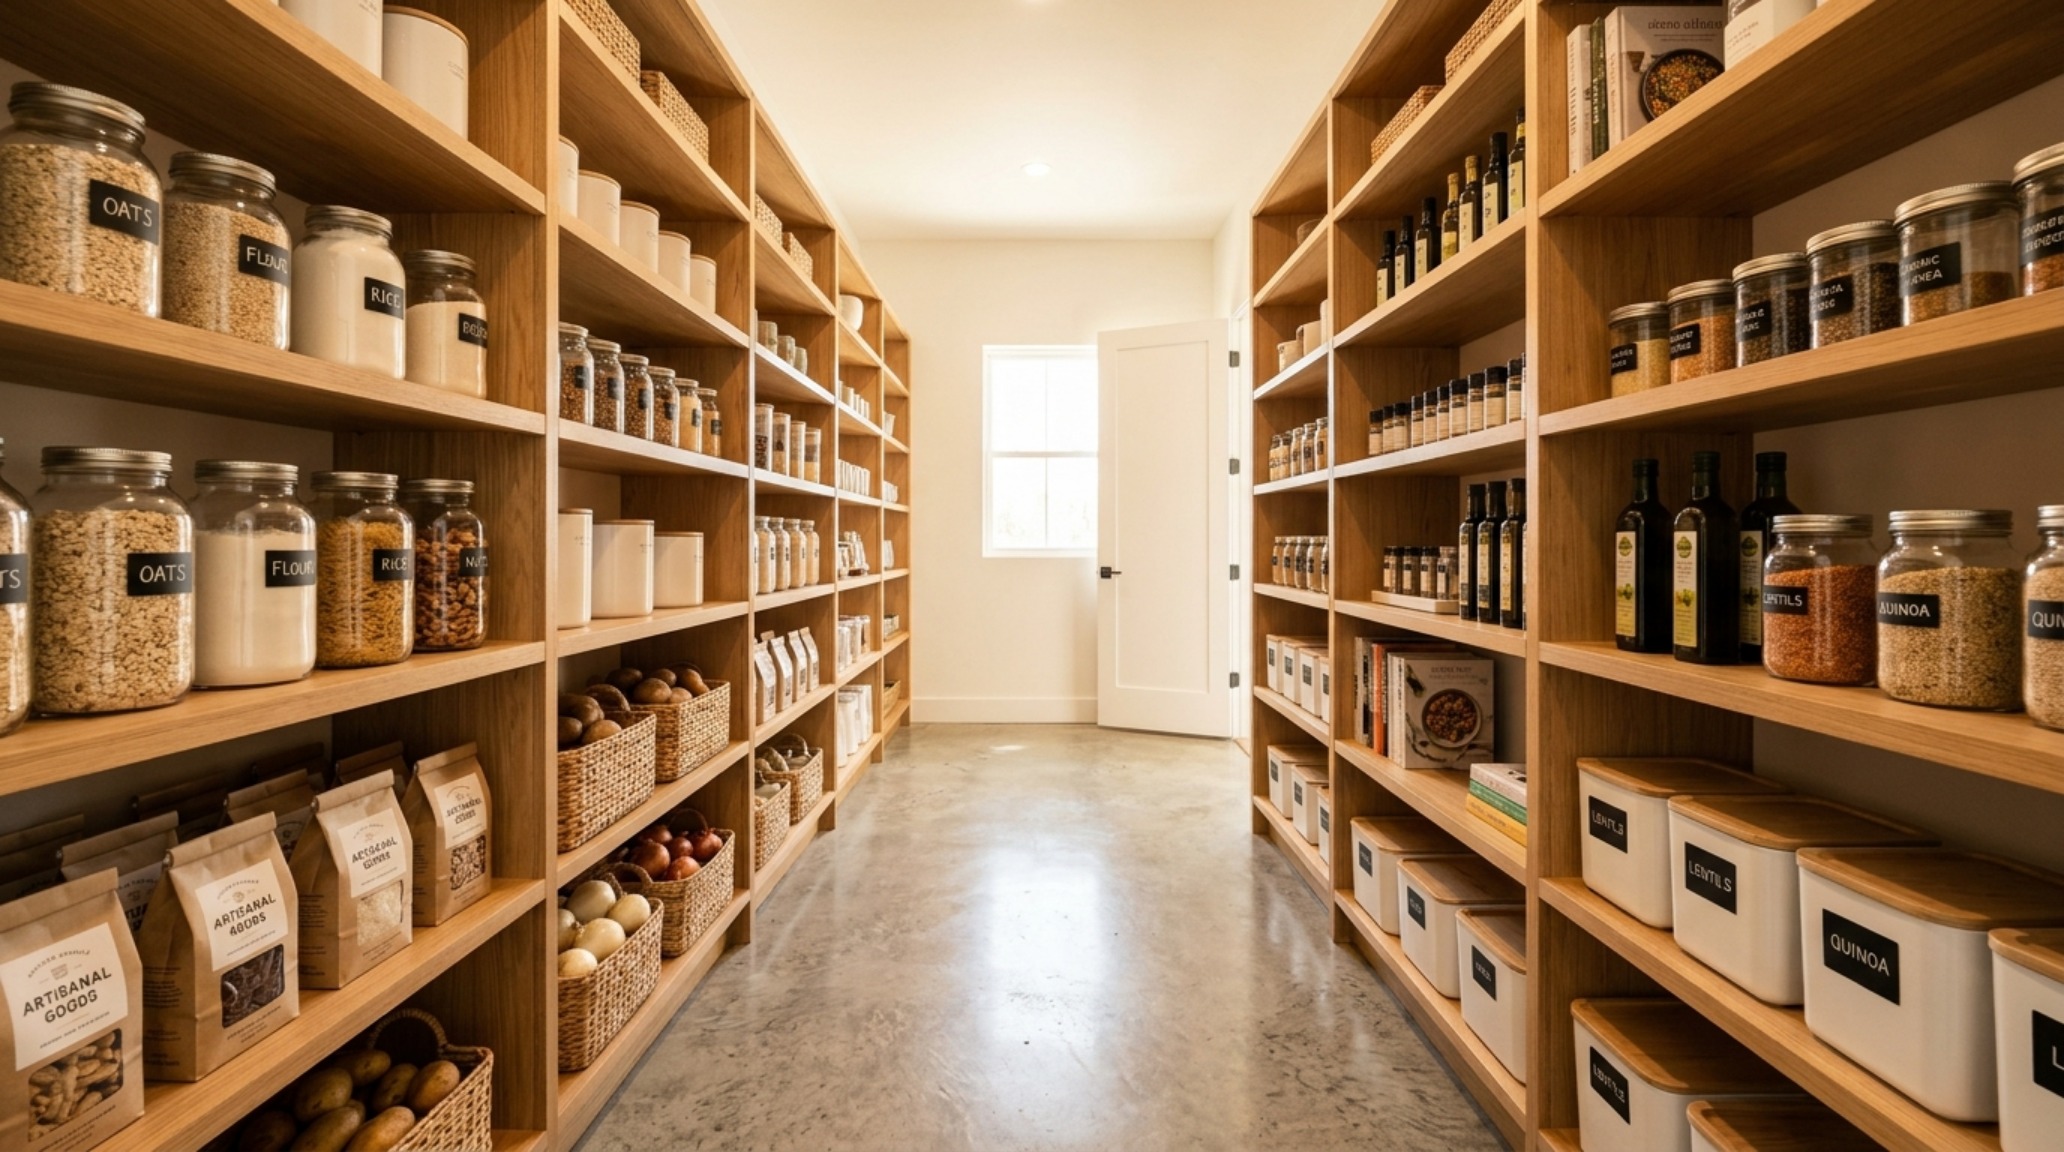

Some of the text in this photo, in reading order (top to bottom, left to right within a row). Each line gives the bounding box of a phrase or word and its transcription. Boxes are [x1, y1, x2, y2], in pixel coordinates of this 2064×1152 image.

[103, 196, 152, 228] OATS
[371, 286, 401, 309] RICE
[139, 564, 187, 583] OATS
[1830, 933, 1890, 976] QUINOA
